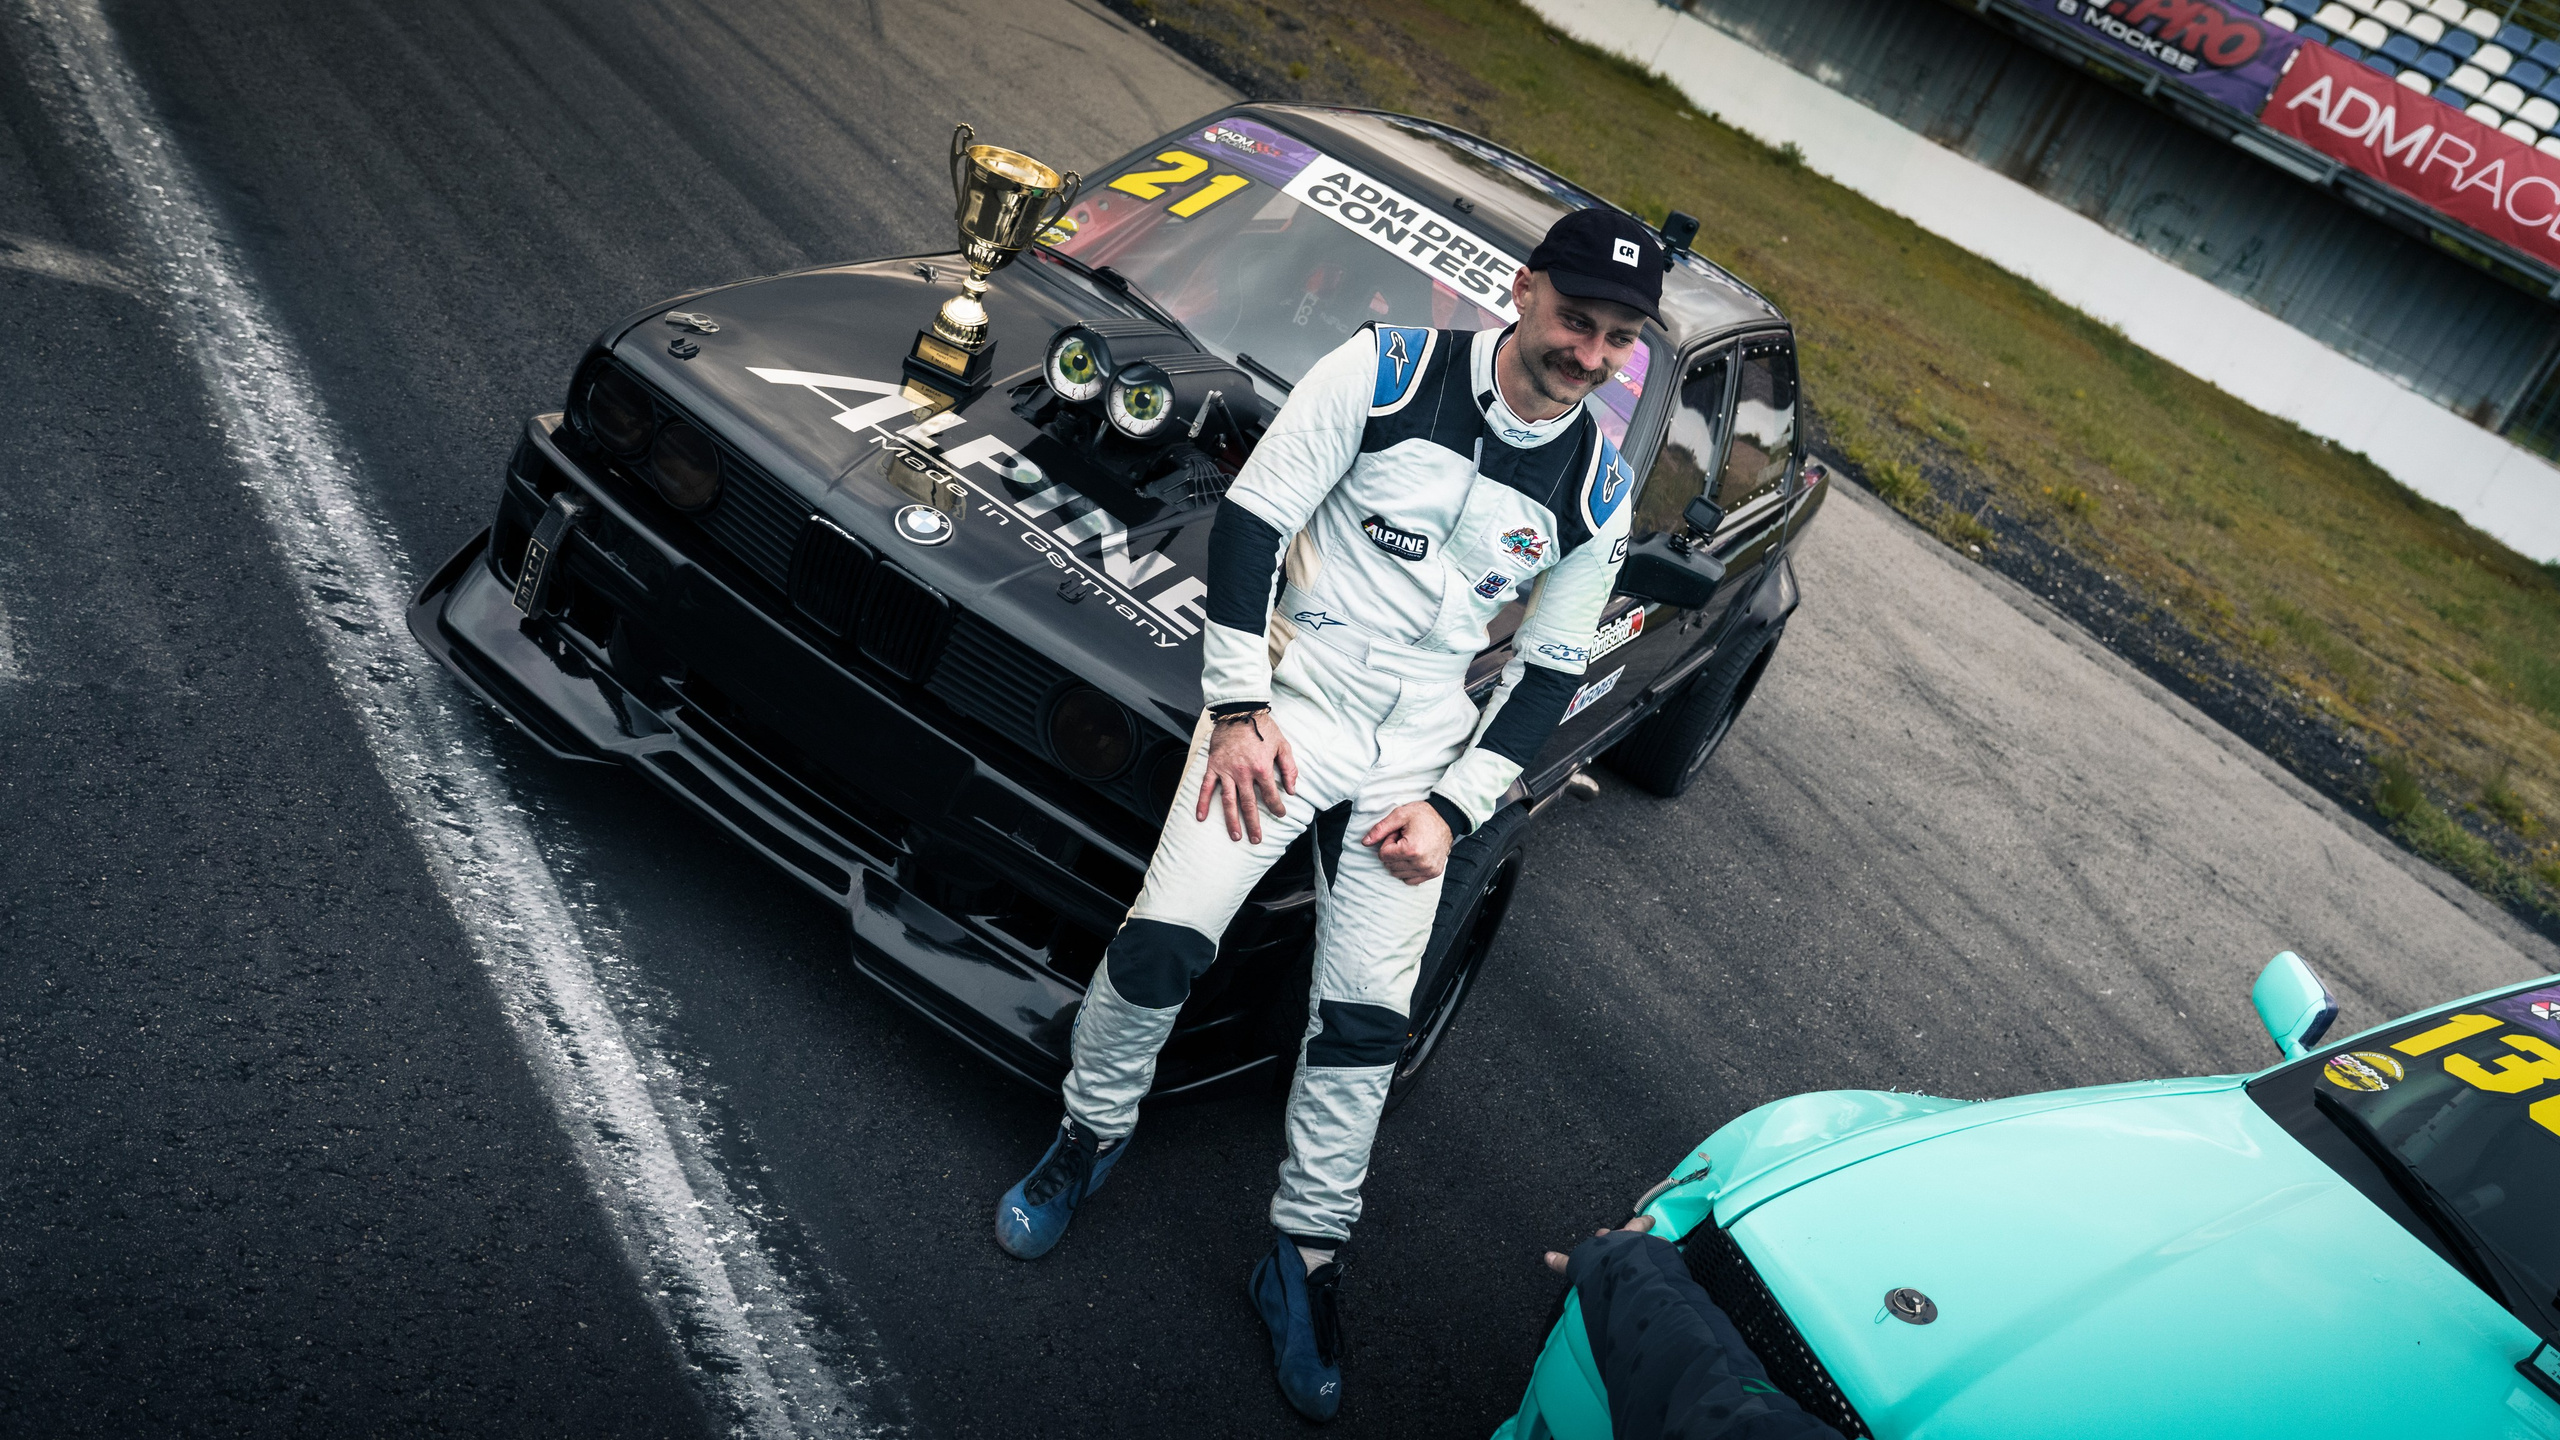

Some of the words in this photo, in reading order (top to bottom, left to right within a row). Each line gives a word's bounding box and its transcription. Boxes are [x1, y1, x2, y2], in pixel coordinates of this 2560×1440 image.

[2083, 6, 2199, 74] МОСКВЕ
[2088, 0, 2262, 67] .PRO
[1220, 130, 1256, 147] ADM
[1107, 150, 1251, 219] 21
[1307, 184, 1516, 309] CONTEST
[1322, 172, 1419, 226] ADM
[1419, 219, 1520, 277] DRIF
[1619, 245, 1635, 259] CR
[745, 366, 1208, 636] ALPINE
[868, 436, 969, 499] Made
[978, 502, 1010, 528] in
[1020, 530, 1180, 650] Germany
[1365, 524, 1426, 553] ALPINE
[2389, 1013, 2560, 1138] 13
